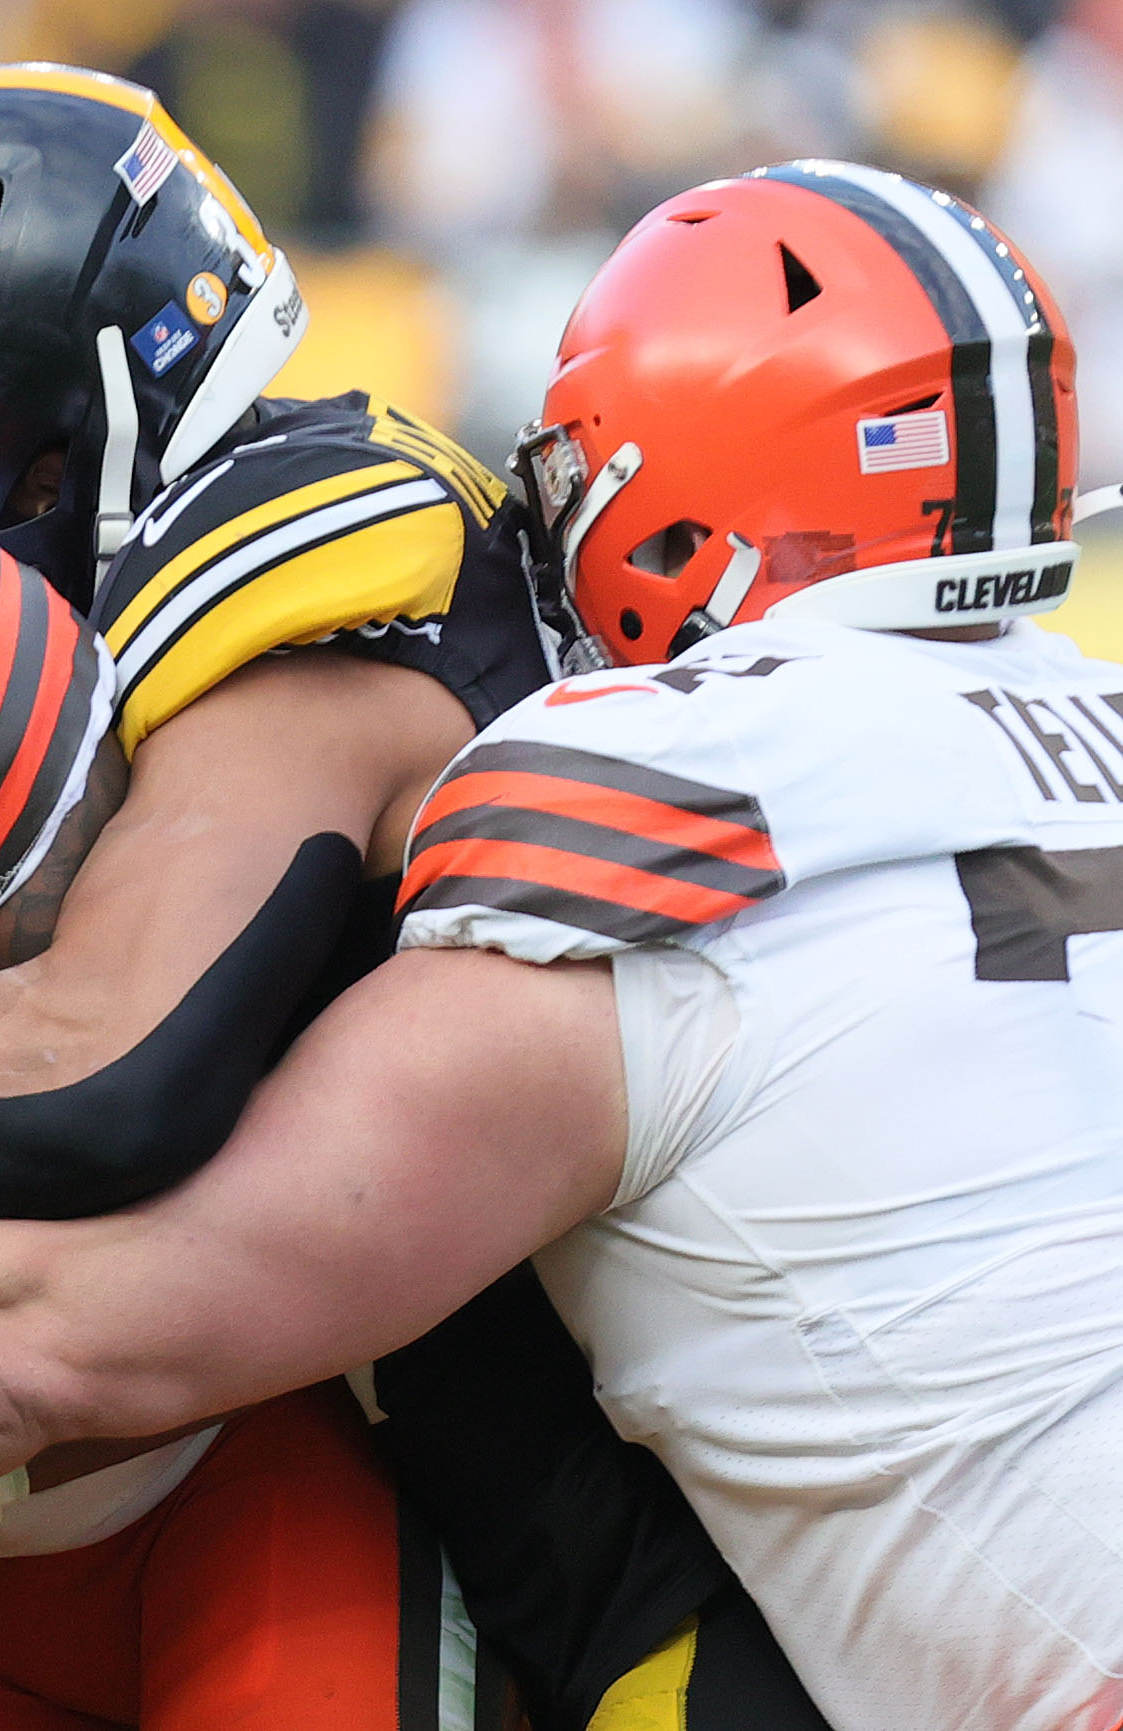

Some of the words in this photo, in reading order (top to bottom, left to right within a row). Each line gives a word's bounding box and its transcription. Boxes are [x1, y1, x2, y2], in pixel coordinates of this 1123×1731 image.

[193, 277, 223, 319] 3
[922, 498, 957, 557] 7
[956, 687, 1123, 803] TEL
